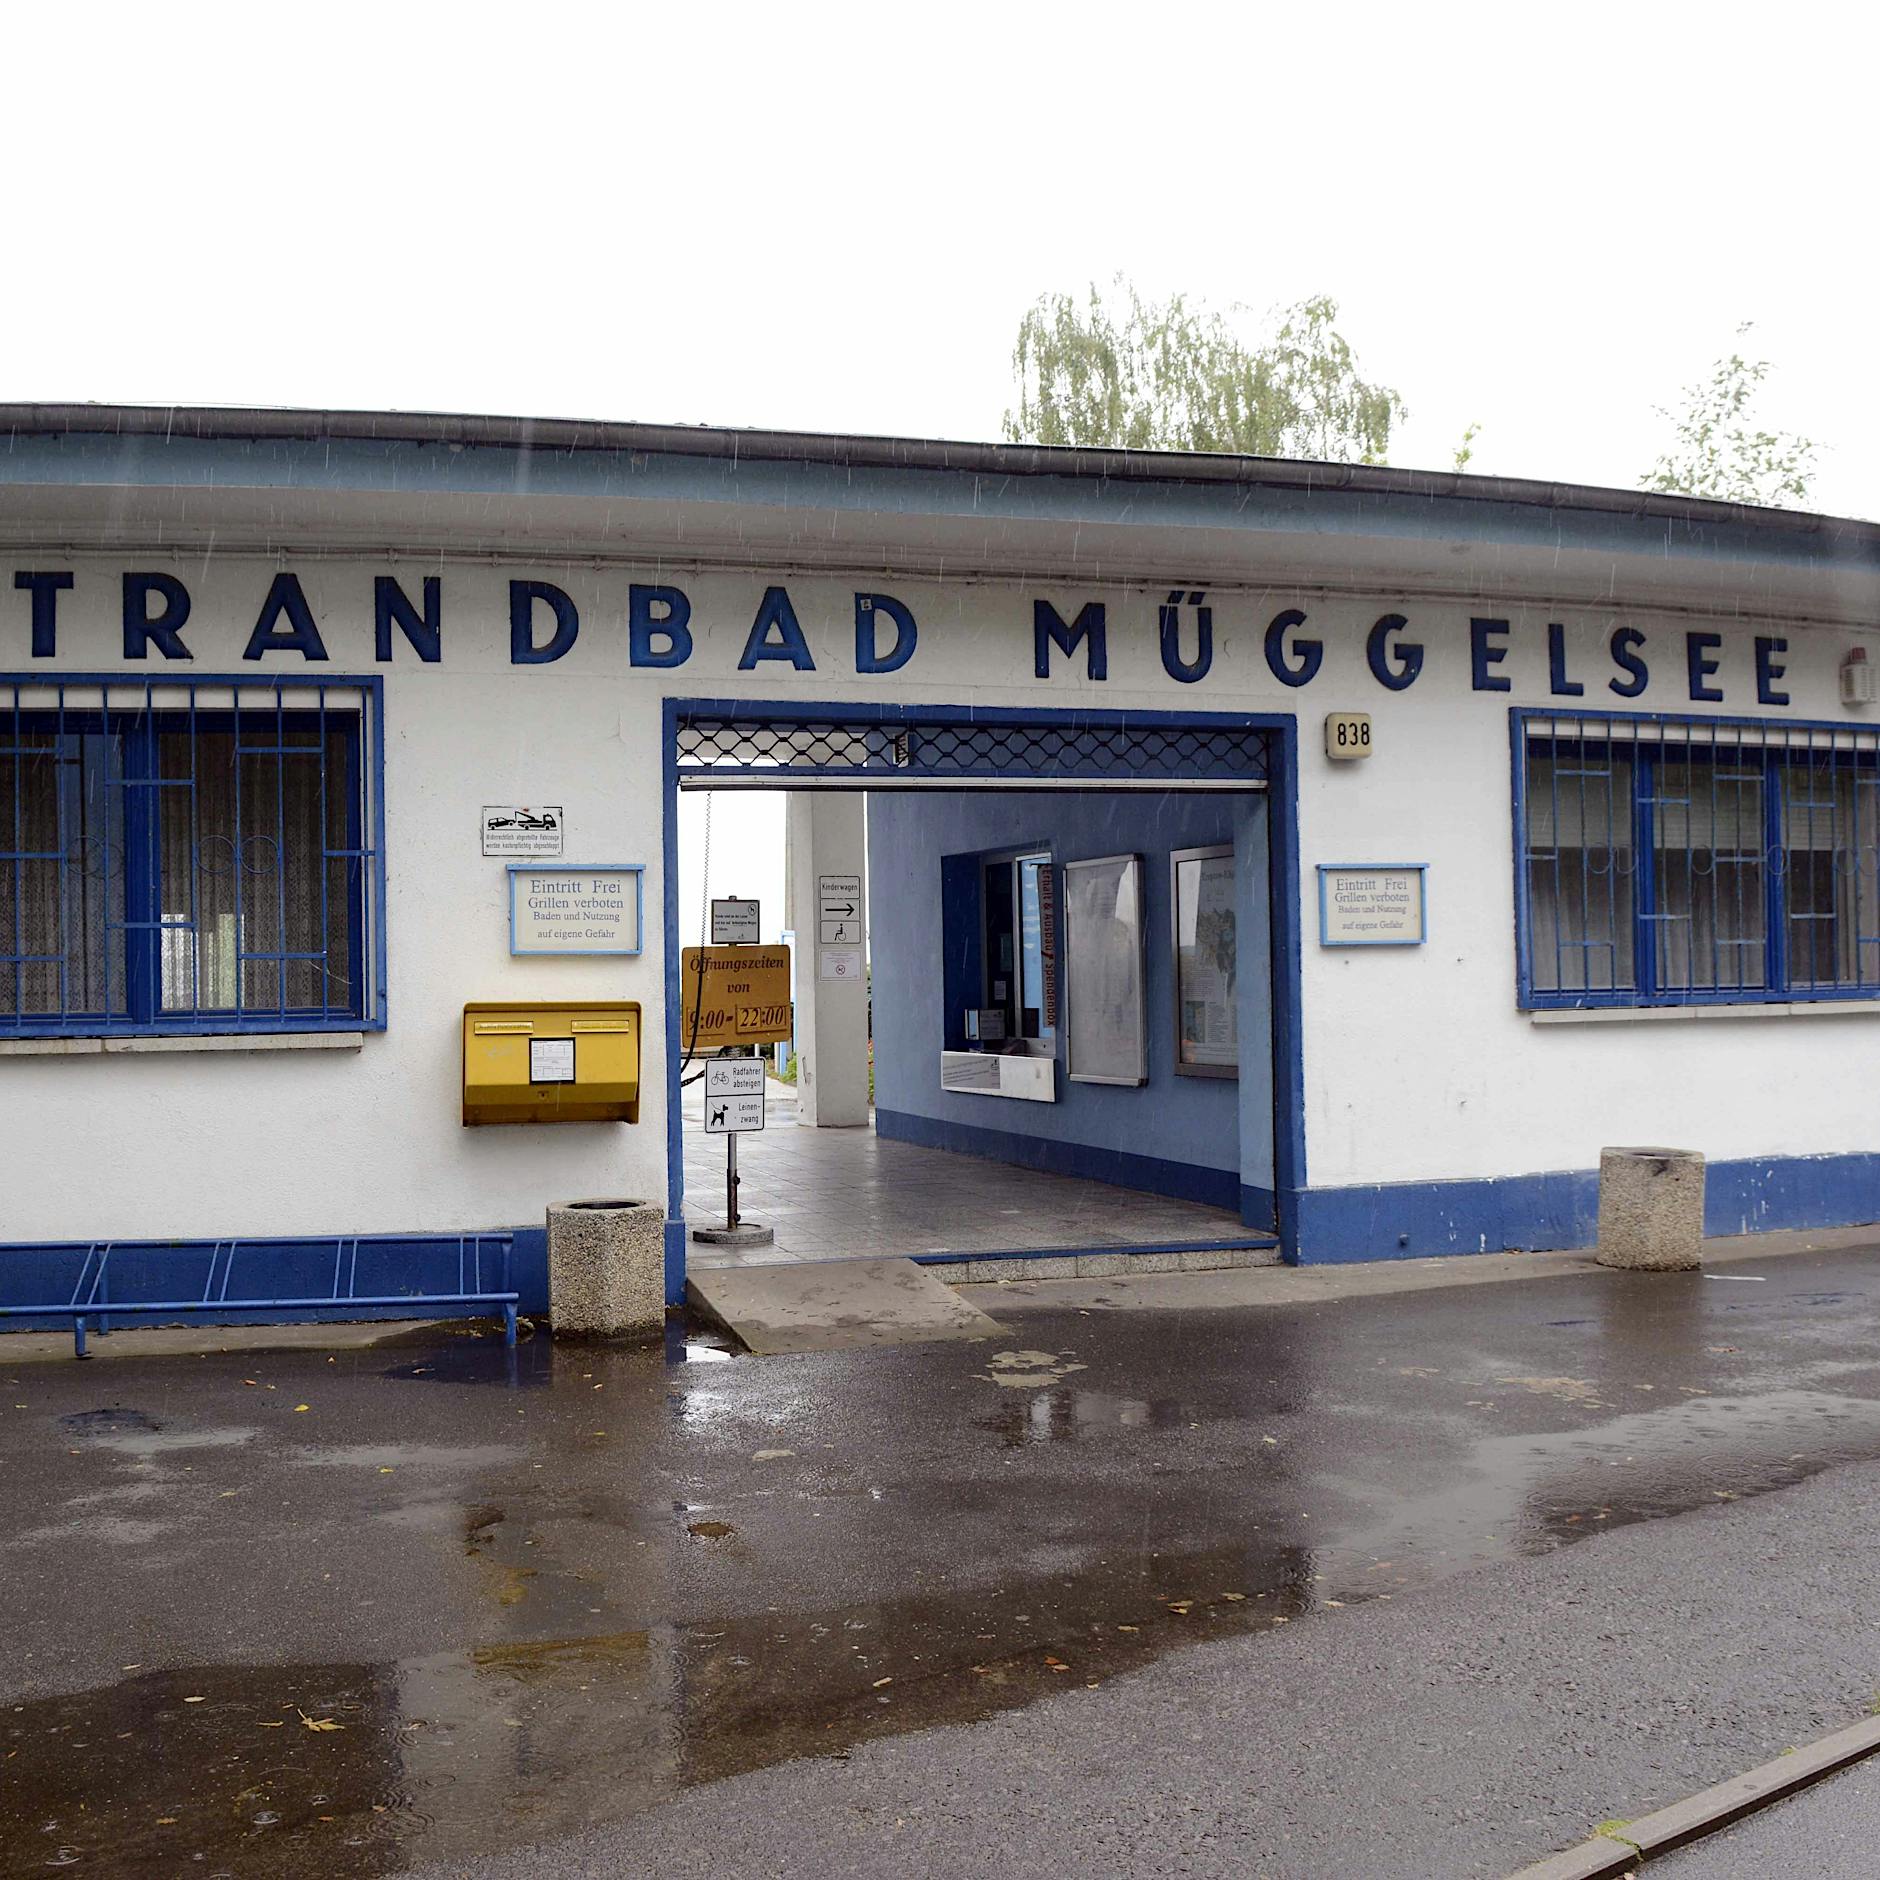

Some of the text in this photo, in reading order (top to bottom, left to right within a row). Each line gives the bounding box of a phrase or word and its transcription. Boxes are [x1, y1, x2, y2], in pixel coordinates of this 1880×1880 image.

[1033, 590, 1790, 706] MÜGGELSEE
[1337, 722, 1370, 746] 838
[530, 879, 621, 894] Eintritt Frei
[822, 883, 858, 893] Kinderwagen
[1335, 877, 1408, 891] Eintritt Frei
[528, 896, 624, 909] Grillen verboten
[1334, 892, 1410, 903] Grillen verboten
[1338, 905, 1361, 914] Baden
[1363, 905, 1375, 914] und
[533, 911, 620, 923] Baden und Nutzung
[537, 928, 616, 940] auf eigene Gefahr
[690, 955, 784, 974] Öffnungszeiten
[727, 983, 750, 993] von
[740, 1006, 784, 1028] 22:00
[732, 1066, 761, 1076] Radfahrer
[733, 1080, 761, 1089] absteigen
[738, 1103, 761, 1111] Leinen-
[740, 1116, 759, 1125] zwang
